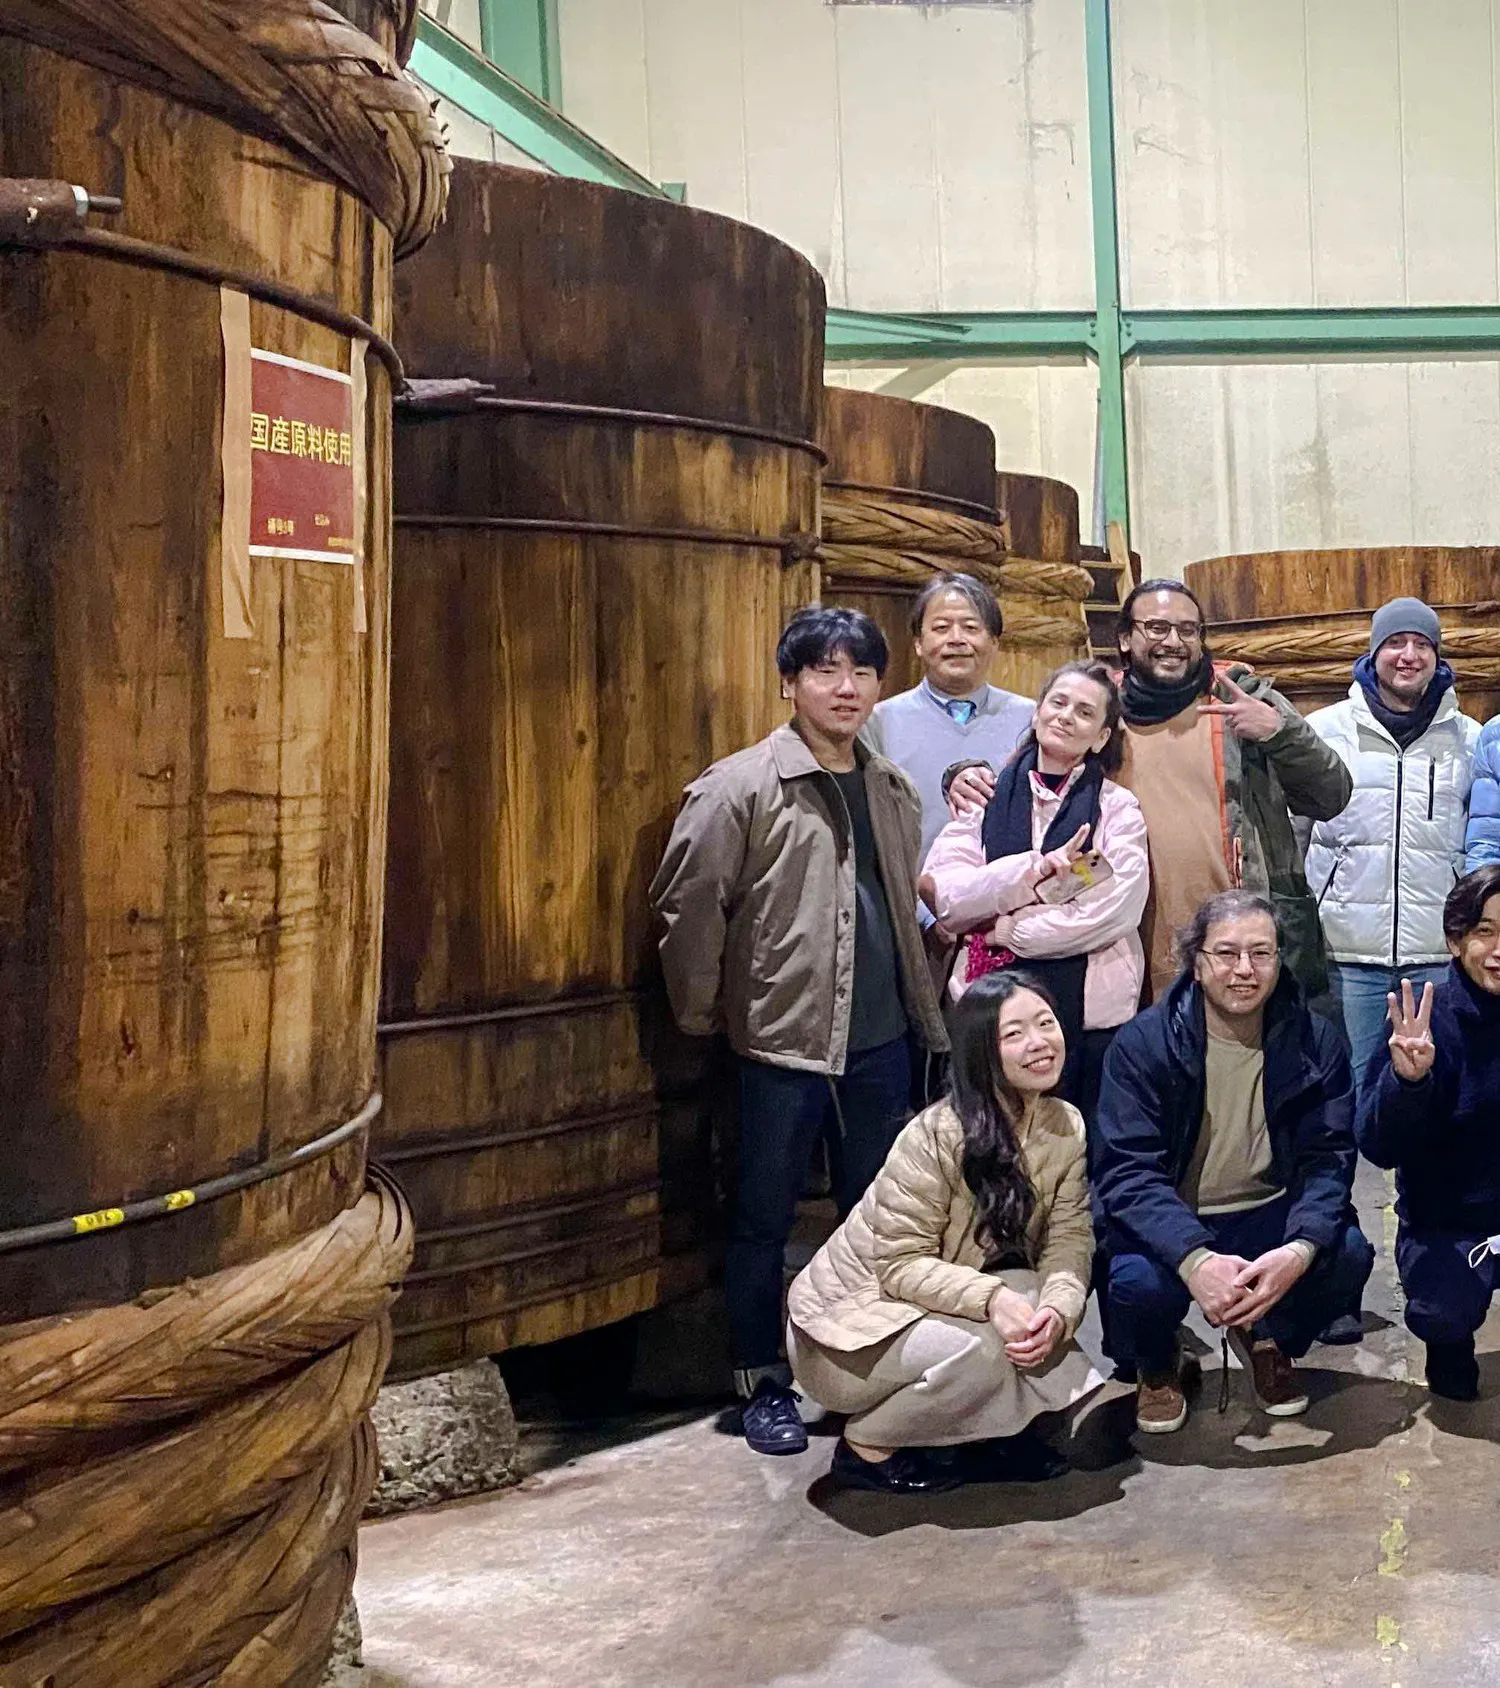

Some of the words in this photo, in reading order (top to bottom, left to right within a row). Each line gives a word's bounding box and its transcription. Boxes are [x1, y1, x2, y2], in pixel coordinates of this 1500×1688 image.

[250, 413, 351, 467] 国産原料使用
